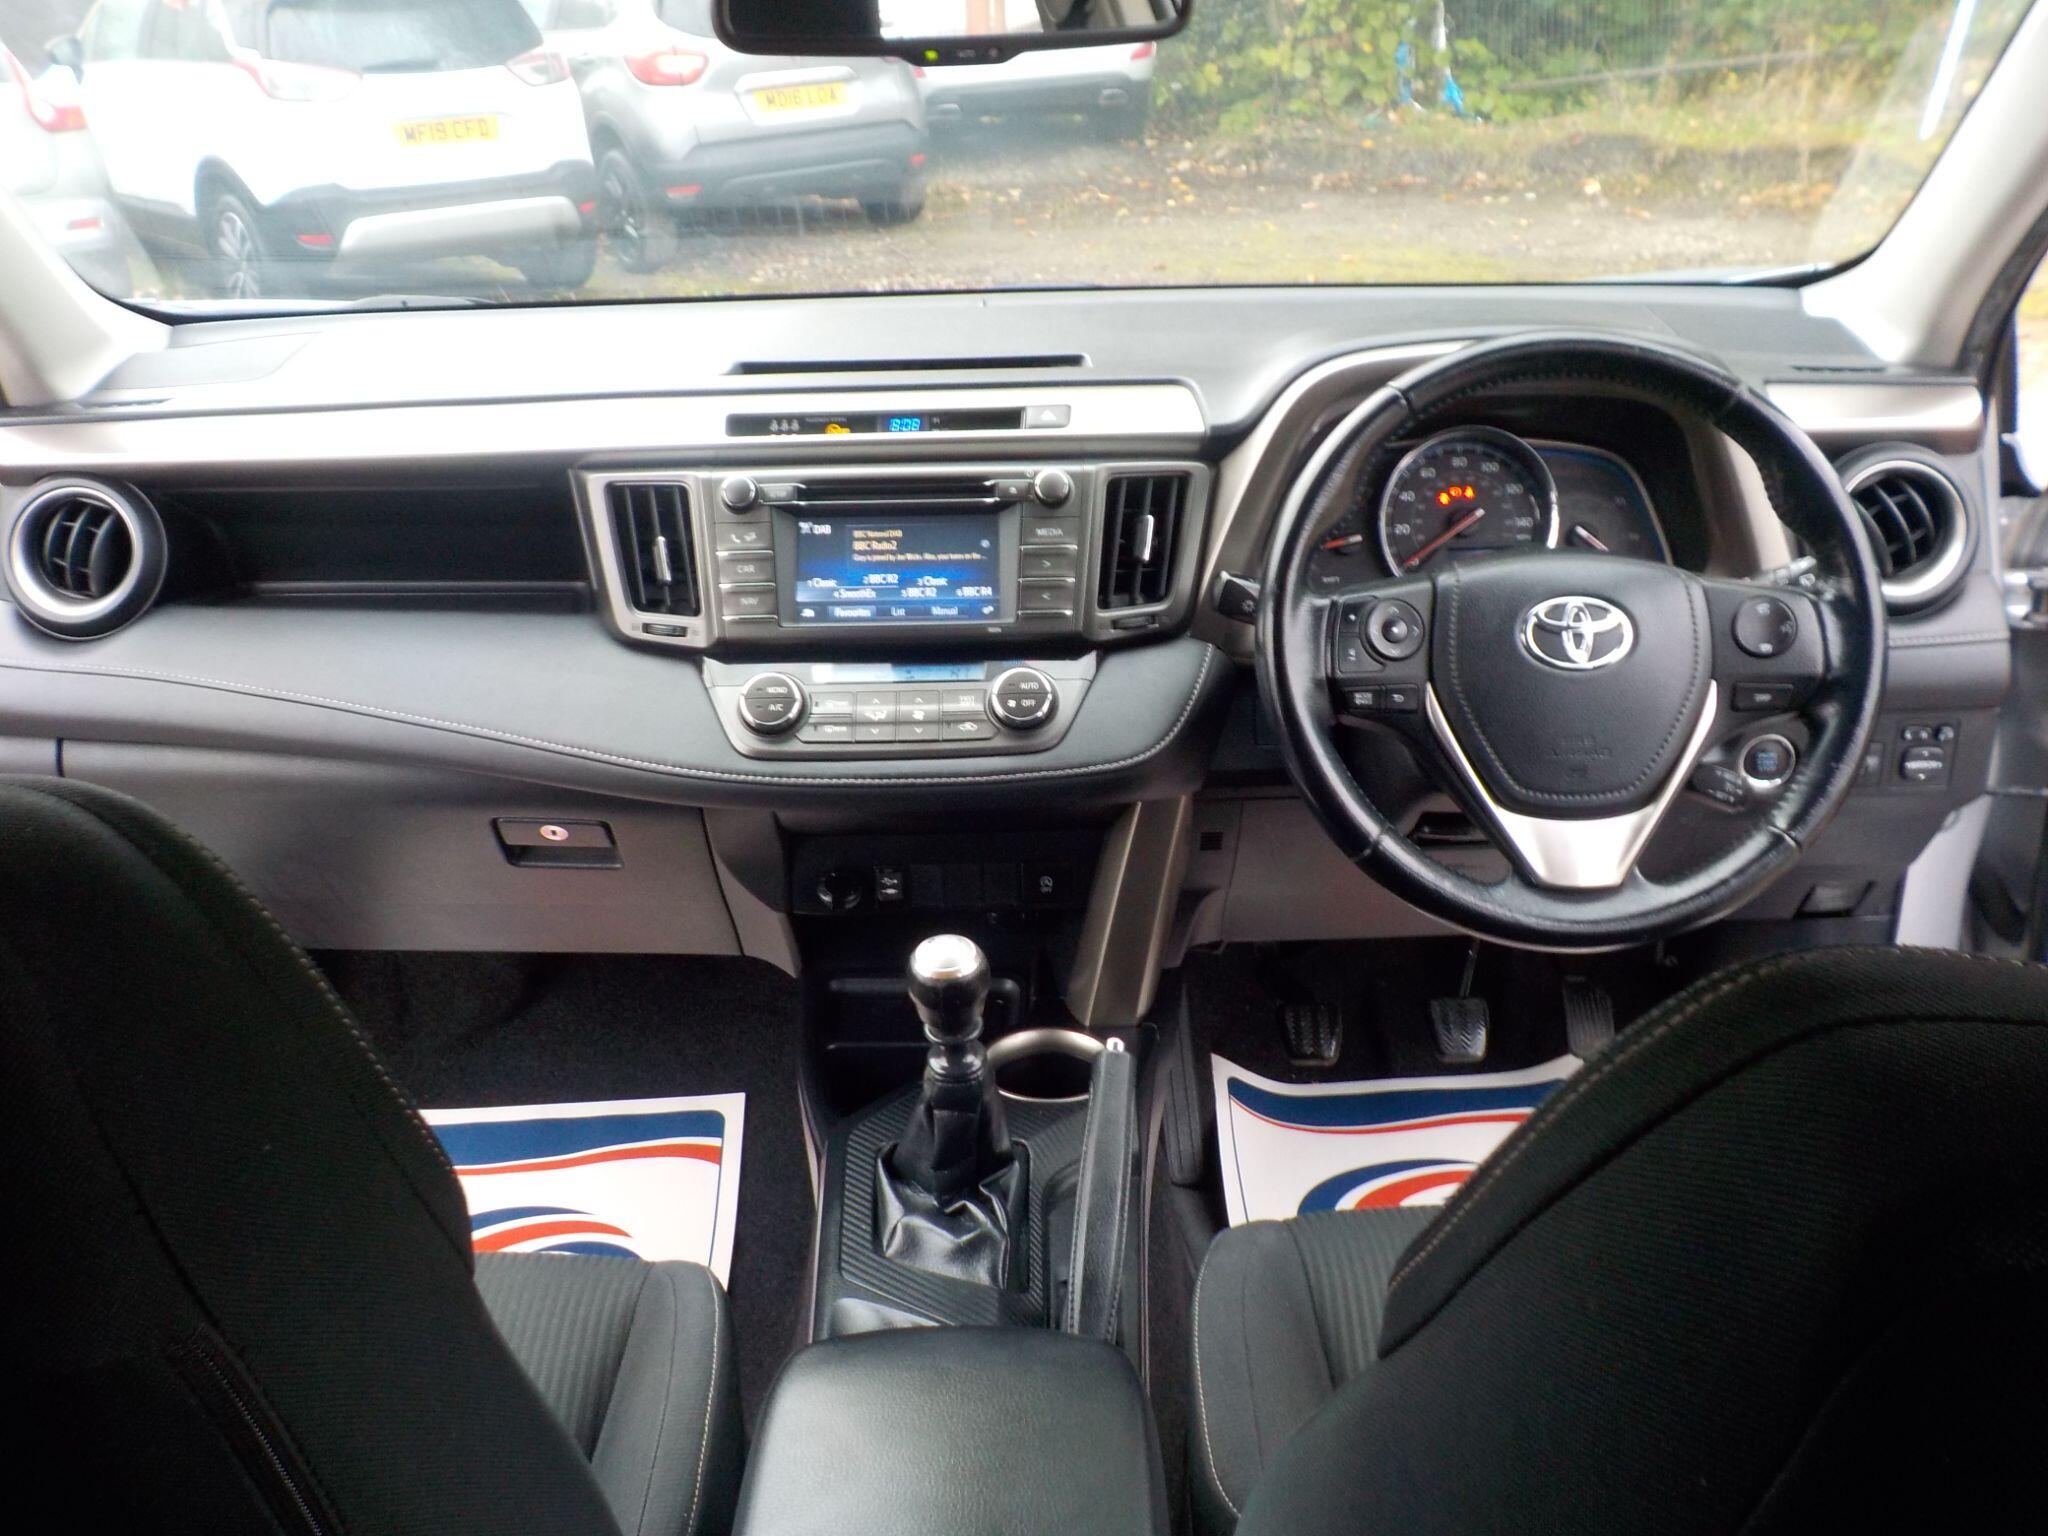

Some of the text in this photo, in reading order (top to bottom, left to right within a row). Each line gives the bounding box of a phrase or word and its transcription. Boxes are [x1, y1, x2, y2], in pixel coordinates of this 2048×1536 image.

[766, 88, 801, 107] MD16
[404, 122, 447, 143] MF19
[888, 417, 921, 432] 8:08
[1451, 456, 1468, 468] 80
[1481, 462, 1500, 472] 100
[1420, 467, 1437, 478] 60
[1399, 490, 1416, 502] 40
[813, 524, 832, 535] DAB
[1035, 528, 1064, 537] MEDIA
[852, 540, 871, 550] BBC
[737, 564, 756, 573] CAR
[813, 577, 838, 588] Classic
[868, 573, 887, 584] BBC
[923, 575, 948, 586] Classic
[907, 587, 925, 598] BBC
[962, 586, 981, 597] BBC
[890, 606, 906, 617] List
[931, 606, 959, 617] Manual
[1019, 681, 1040, 691] AUTO
[768, 702, 785, 712] A/C
